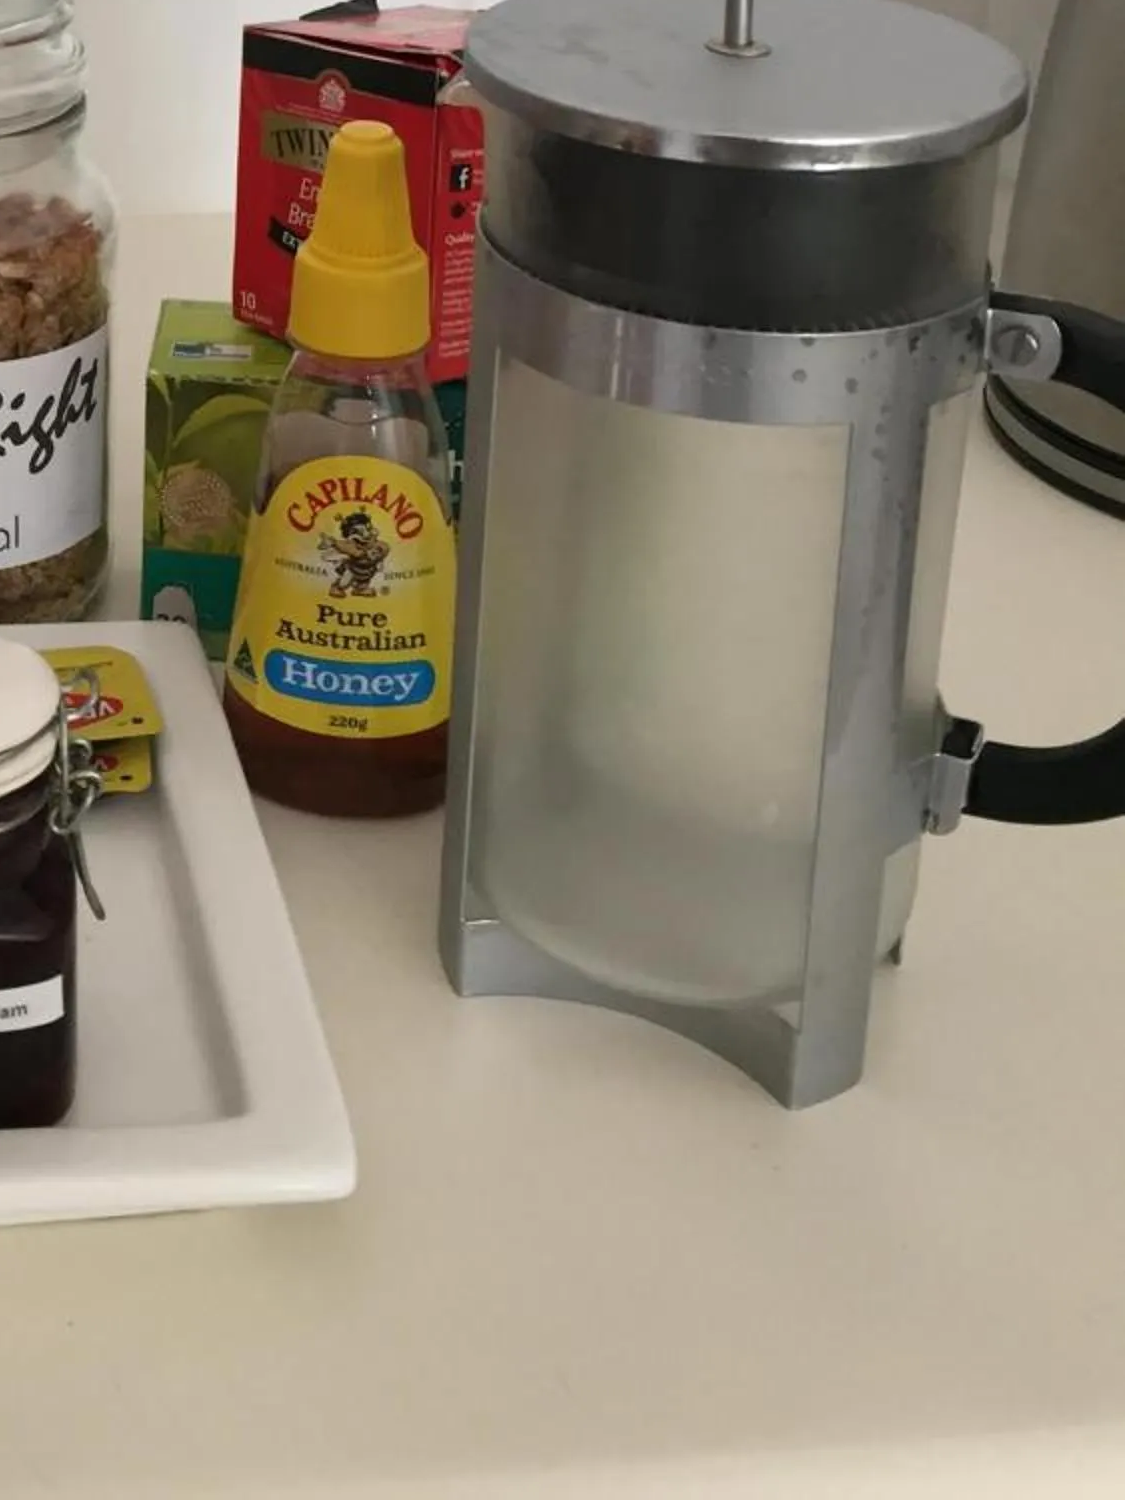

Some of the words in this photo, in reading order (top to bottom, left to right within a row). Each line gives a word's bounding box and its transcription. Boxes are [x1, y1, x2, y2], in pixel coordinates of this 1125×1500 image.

[239, 291, 256, 309] 10
[287, 477, 424, 540] CAPILANO
[316, 604, 388, 629] Pure
[275, 619, 427, 652] Australian
[283, 656, 421, 701] Honey
[328, 714, 368, 732] 220g
